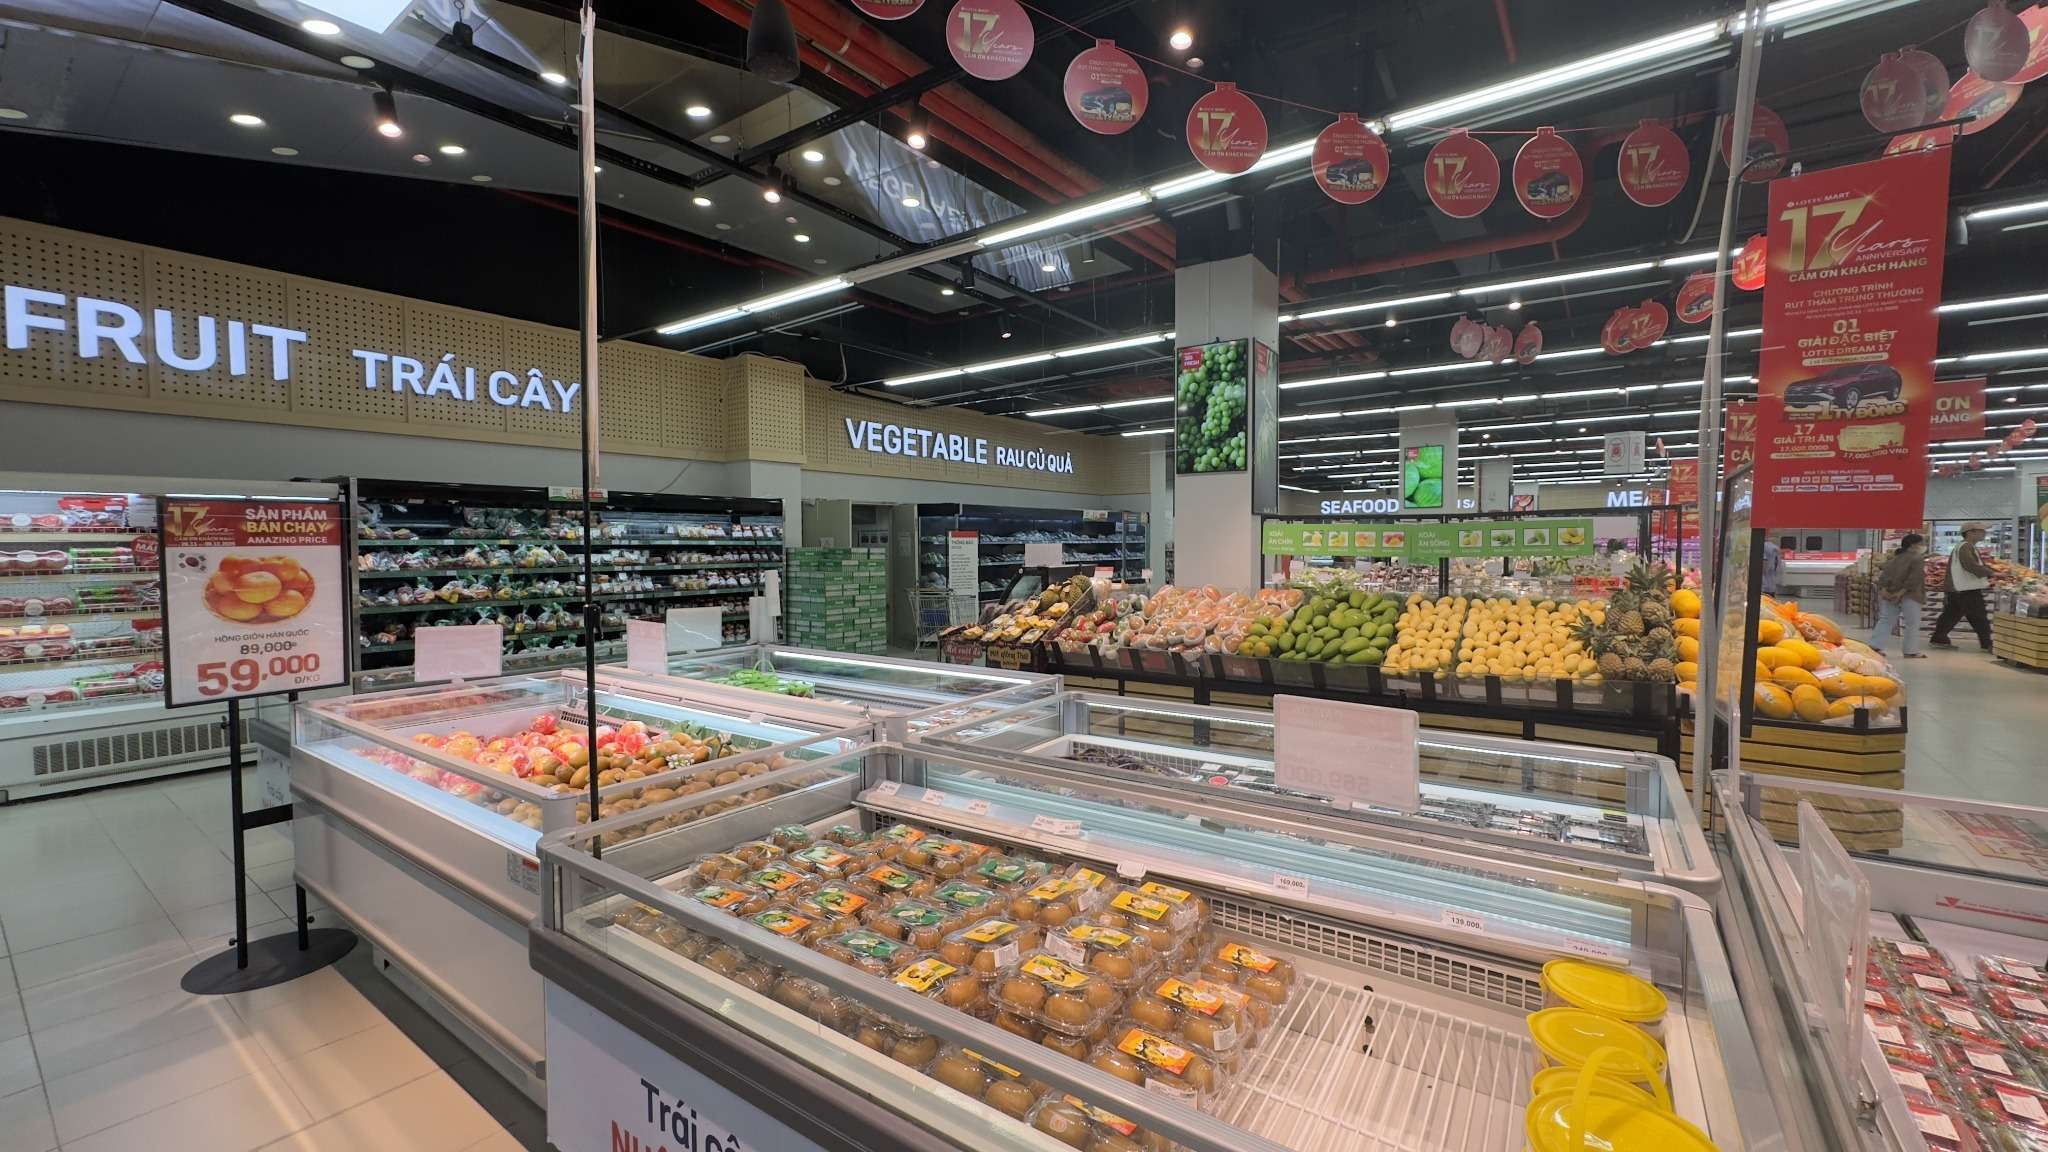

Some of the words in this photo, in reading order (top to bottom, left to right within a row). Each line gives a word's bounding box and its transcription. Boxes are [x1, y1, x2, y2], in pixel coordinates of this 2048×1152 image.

[958, 11, 1000, 54] 17
[1197, 112, 1235, 151] 17
[1434, 157, 1467, 194] 17
[1627, 146, 1660, 185] 17
[1780, 196, 1873, 272] 17
[1830, 219, 1929, 265] Years
[1840, 261, 1886, 276] KHÁCH
[1855, 246, 1928, 262] ANNIVERSARY
[1833, 318, 1860, 334] 01
[4, 284, 307, 382] FRUIT
[352, 348, 476, 401] TRÁI
[487, 368, 581, 413] CÂY
[1794, 424, 1815, 435] 17
[1930, 411, 1969, 424] HÀNG
[845, 418, 988, 465] VEGETABLE
[996, 446, 1025, 468] RAU
[168, 506, 210, 537] 17
[1321, 499, 1399, 514] SEAFOOD
[247, 536, 297, 544] AMAZING
[299, 536, 328, 544] PRICE
[284, 521, 327, 537] CHẠY
[197, 653, 320, 696] 59,000
[641, 1078, 697, 1152] Trái
